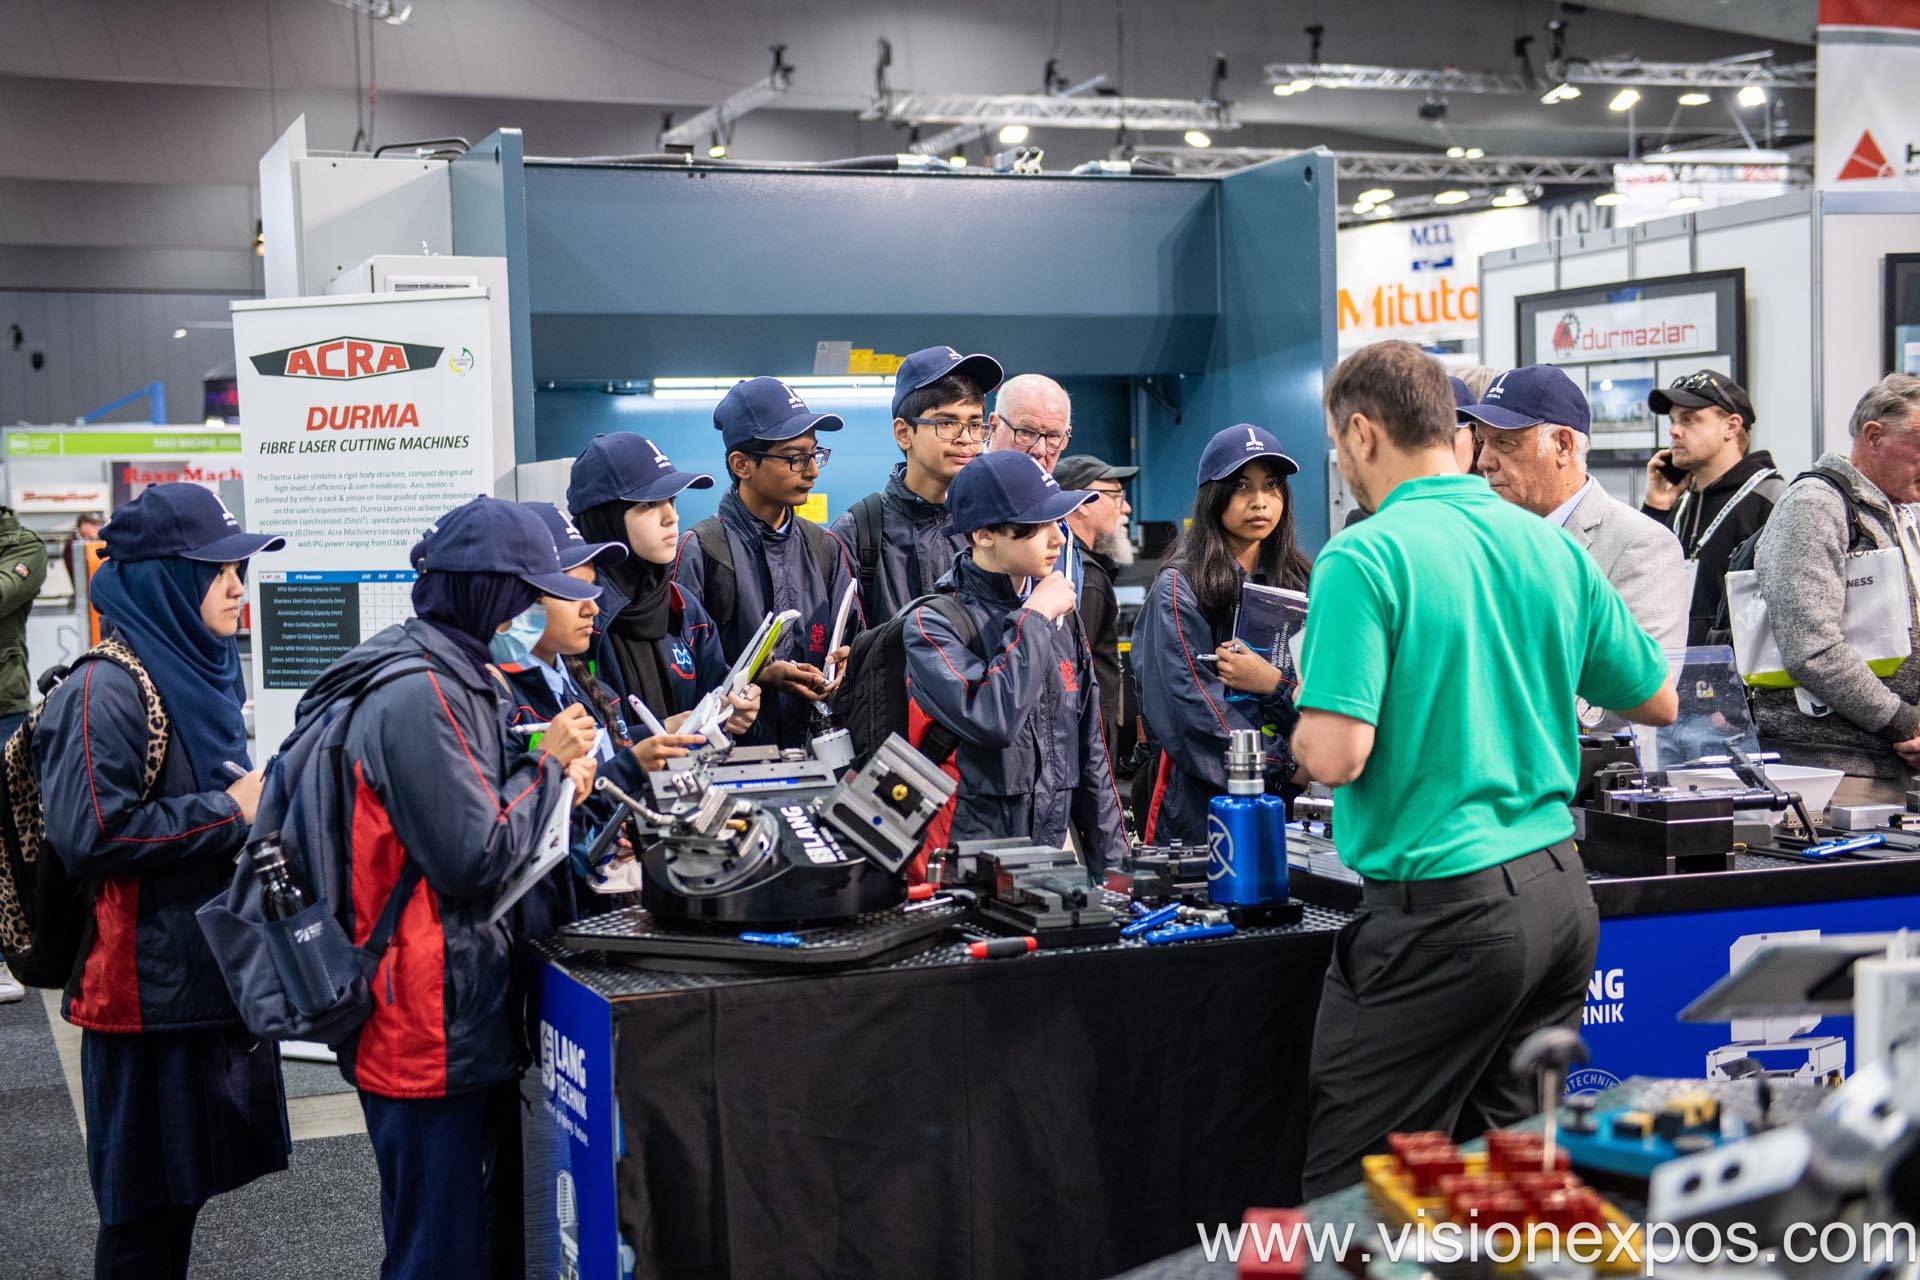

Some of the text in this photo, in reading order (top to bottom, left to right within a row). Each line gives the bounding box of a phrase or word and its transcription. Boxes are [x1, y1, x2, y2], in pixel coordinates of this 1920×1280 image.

[1338, 278, 1479, 331] Mituto
[1582, 320, 1696, 351] durmazlar
[286, 341, 407, 378] ACRA
[306, 402, 420, 432] DURMA
[259, 435, 470, 455] FIBRE LASER CUTTING MACHINES
[310, 472, 336, 480] contains
[408, 470, 437, 479] compact
[438, 468, 459, 478] design
[1846, 576, 1874, 589] NESS
[780, 806, 825, 849] LANG
[1585, 968, 1624, 1002] NG
[554, 1029, 587, 1090] LANG
